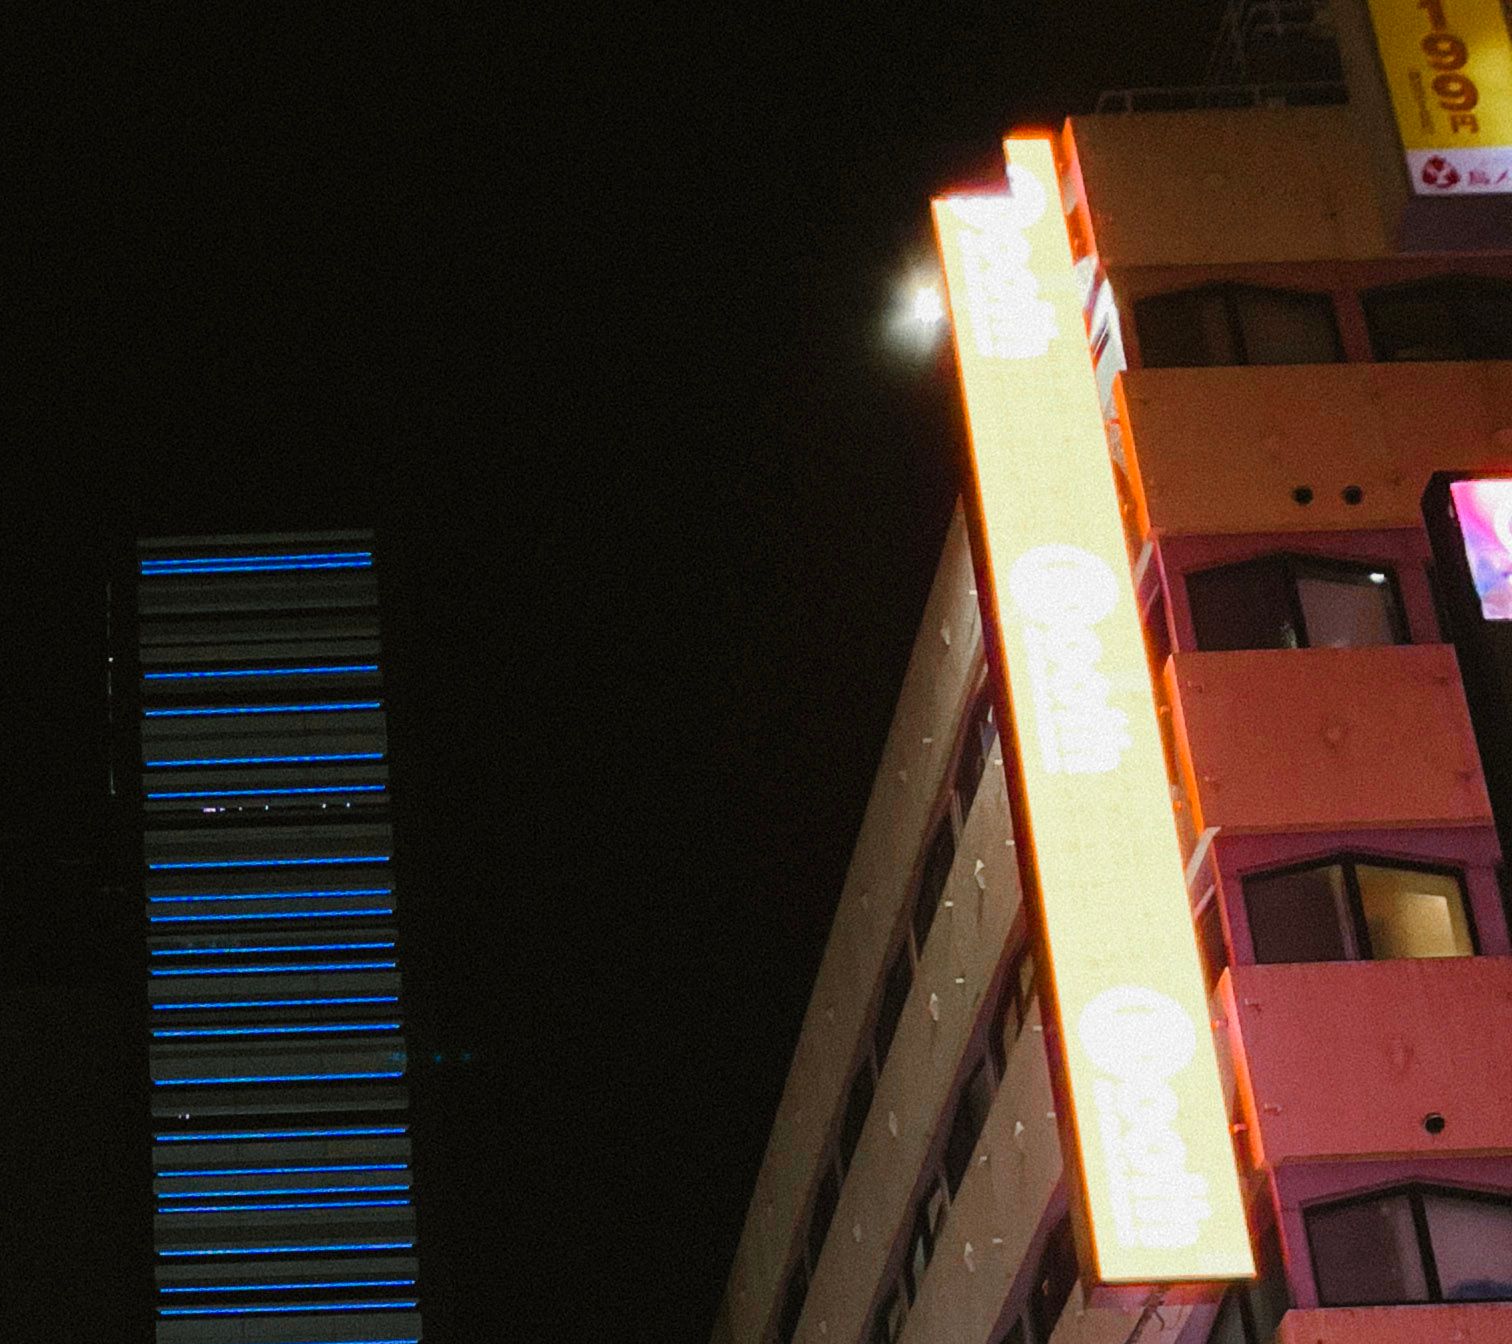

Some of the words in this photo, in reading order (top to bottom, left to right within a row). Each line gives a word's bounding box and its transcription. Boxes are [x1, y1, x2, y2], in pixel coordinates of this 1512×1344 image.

[947, 163, 1059, 360] ooth
[1009, 544, 1131, 774] ooth
[1079, 985, 1213, 1249] ooth
